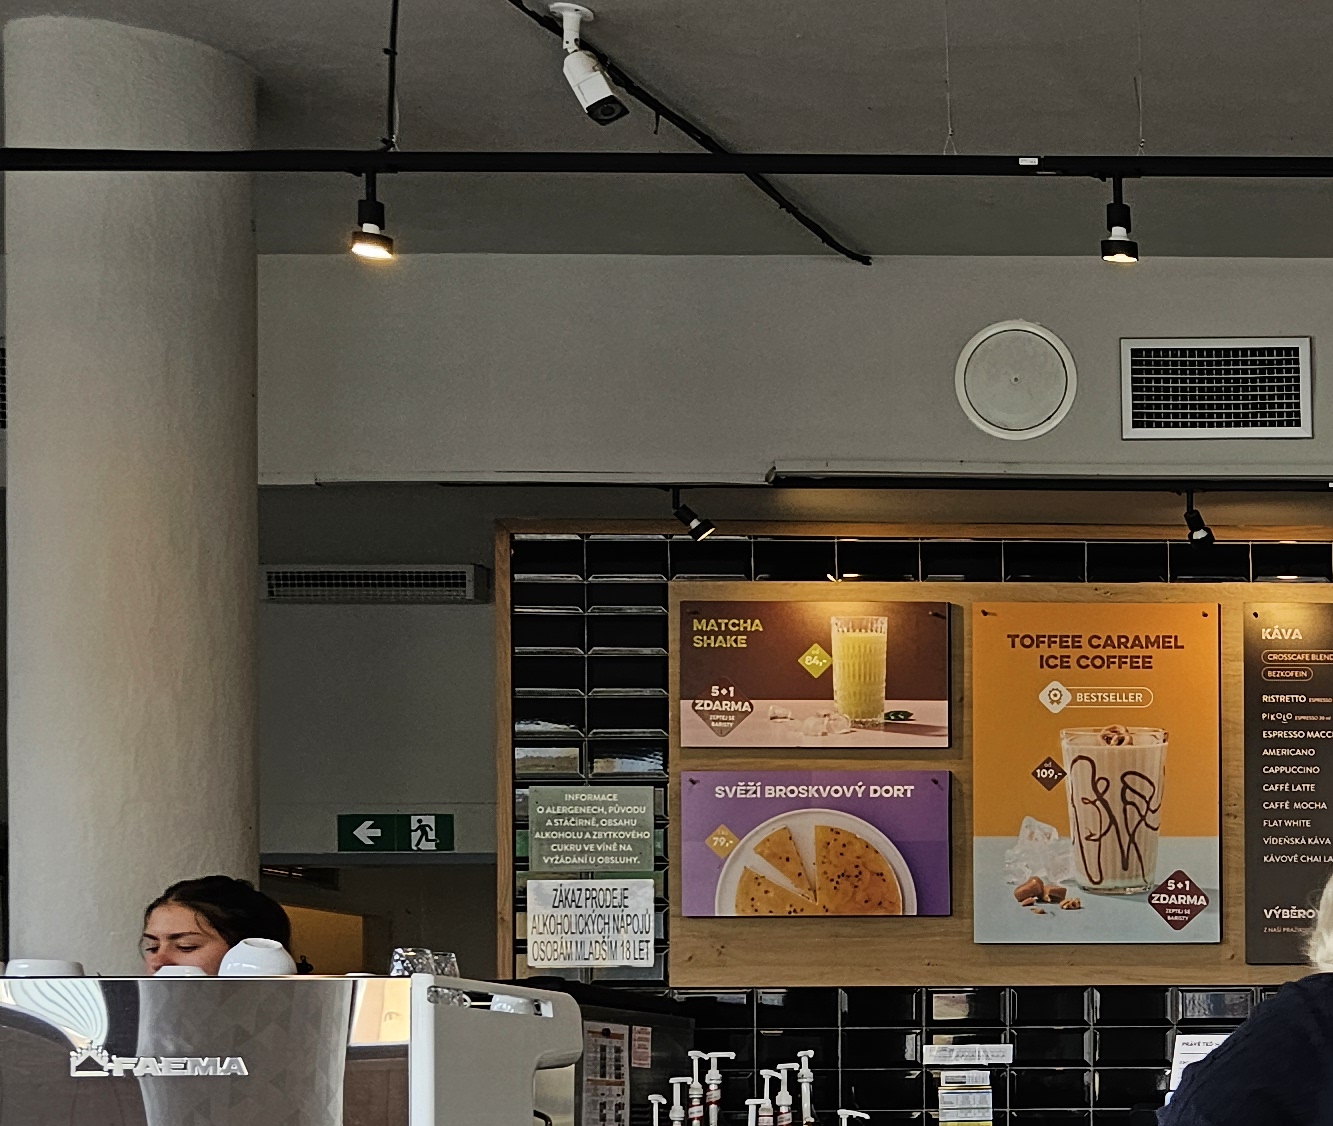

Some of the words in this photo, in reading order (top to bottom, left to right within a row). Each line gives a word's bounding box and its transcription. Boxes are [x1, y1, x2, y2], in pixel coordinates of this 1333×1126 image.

[693, 619, 763, 631] MATCHA
[1262, 625, 1302, 640] KÁVA
[693, 636, 747, 647] SHAKE
[1007, 634, 1082, 649] TOFFEE
[1088, 635, 1184, 650] CARAMEL
[805, 656, 827, 667] 84,-
[1039, 655, 1071, 669] ICE
[1076, 655, 1153, 669] COFFEE
[1077, 693, 1143, 702] BESTSELLER
[1262, 695, 1306, 703] RISTRETTO
[695, 700, 751, 712] ZDARMA
[1263, 731, 1305, 739] ESPRESSO
[1036, 770, 1062, 780] 109,-
[1263, 766, 1320, 774] CAPPUCCINO
[715, 782, 761, 798] SVĚŽÍ
[765, 782, 866, 798] BROSKVOVÝ
[869, 785, 914, 798] DORT
[546, 806, 607, 815] ALERGENECH,
[608, 804, 646, 813] PŮVODU
[554, 816, 599, 827] STÁČÍRNĚ,
[592, 829, 650, 839] ZBYTKOVÉHO
[1263, 835, 1306, 845] VÍDEŇSKÁ
[1308, 836, 1331, 845] KÁVA
[596, 842, 618, 851] VÍNĚ
[543, 855, 588, 864] VYŽÁDÁNÍ
[552, 884, 582, 908] ZÁKAZ
[585, 888, 628, 908] PRODEJE
[1151, 894, 1207, 905] ZDARMA
[531, 909, 610, 935] ALKOHOLICKÝCH
[613, 909, 650, 934] NÁPOJŮ
[532, 937, 573, 961] OSOBÁM
[575, 936, 617, 961] MLADŠÍM
[621, 940, 631, 960] 18
[633, 940, 650, 960] LET
[112, 1055, 248, 1077] FAEMA
